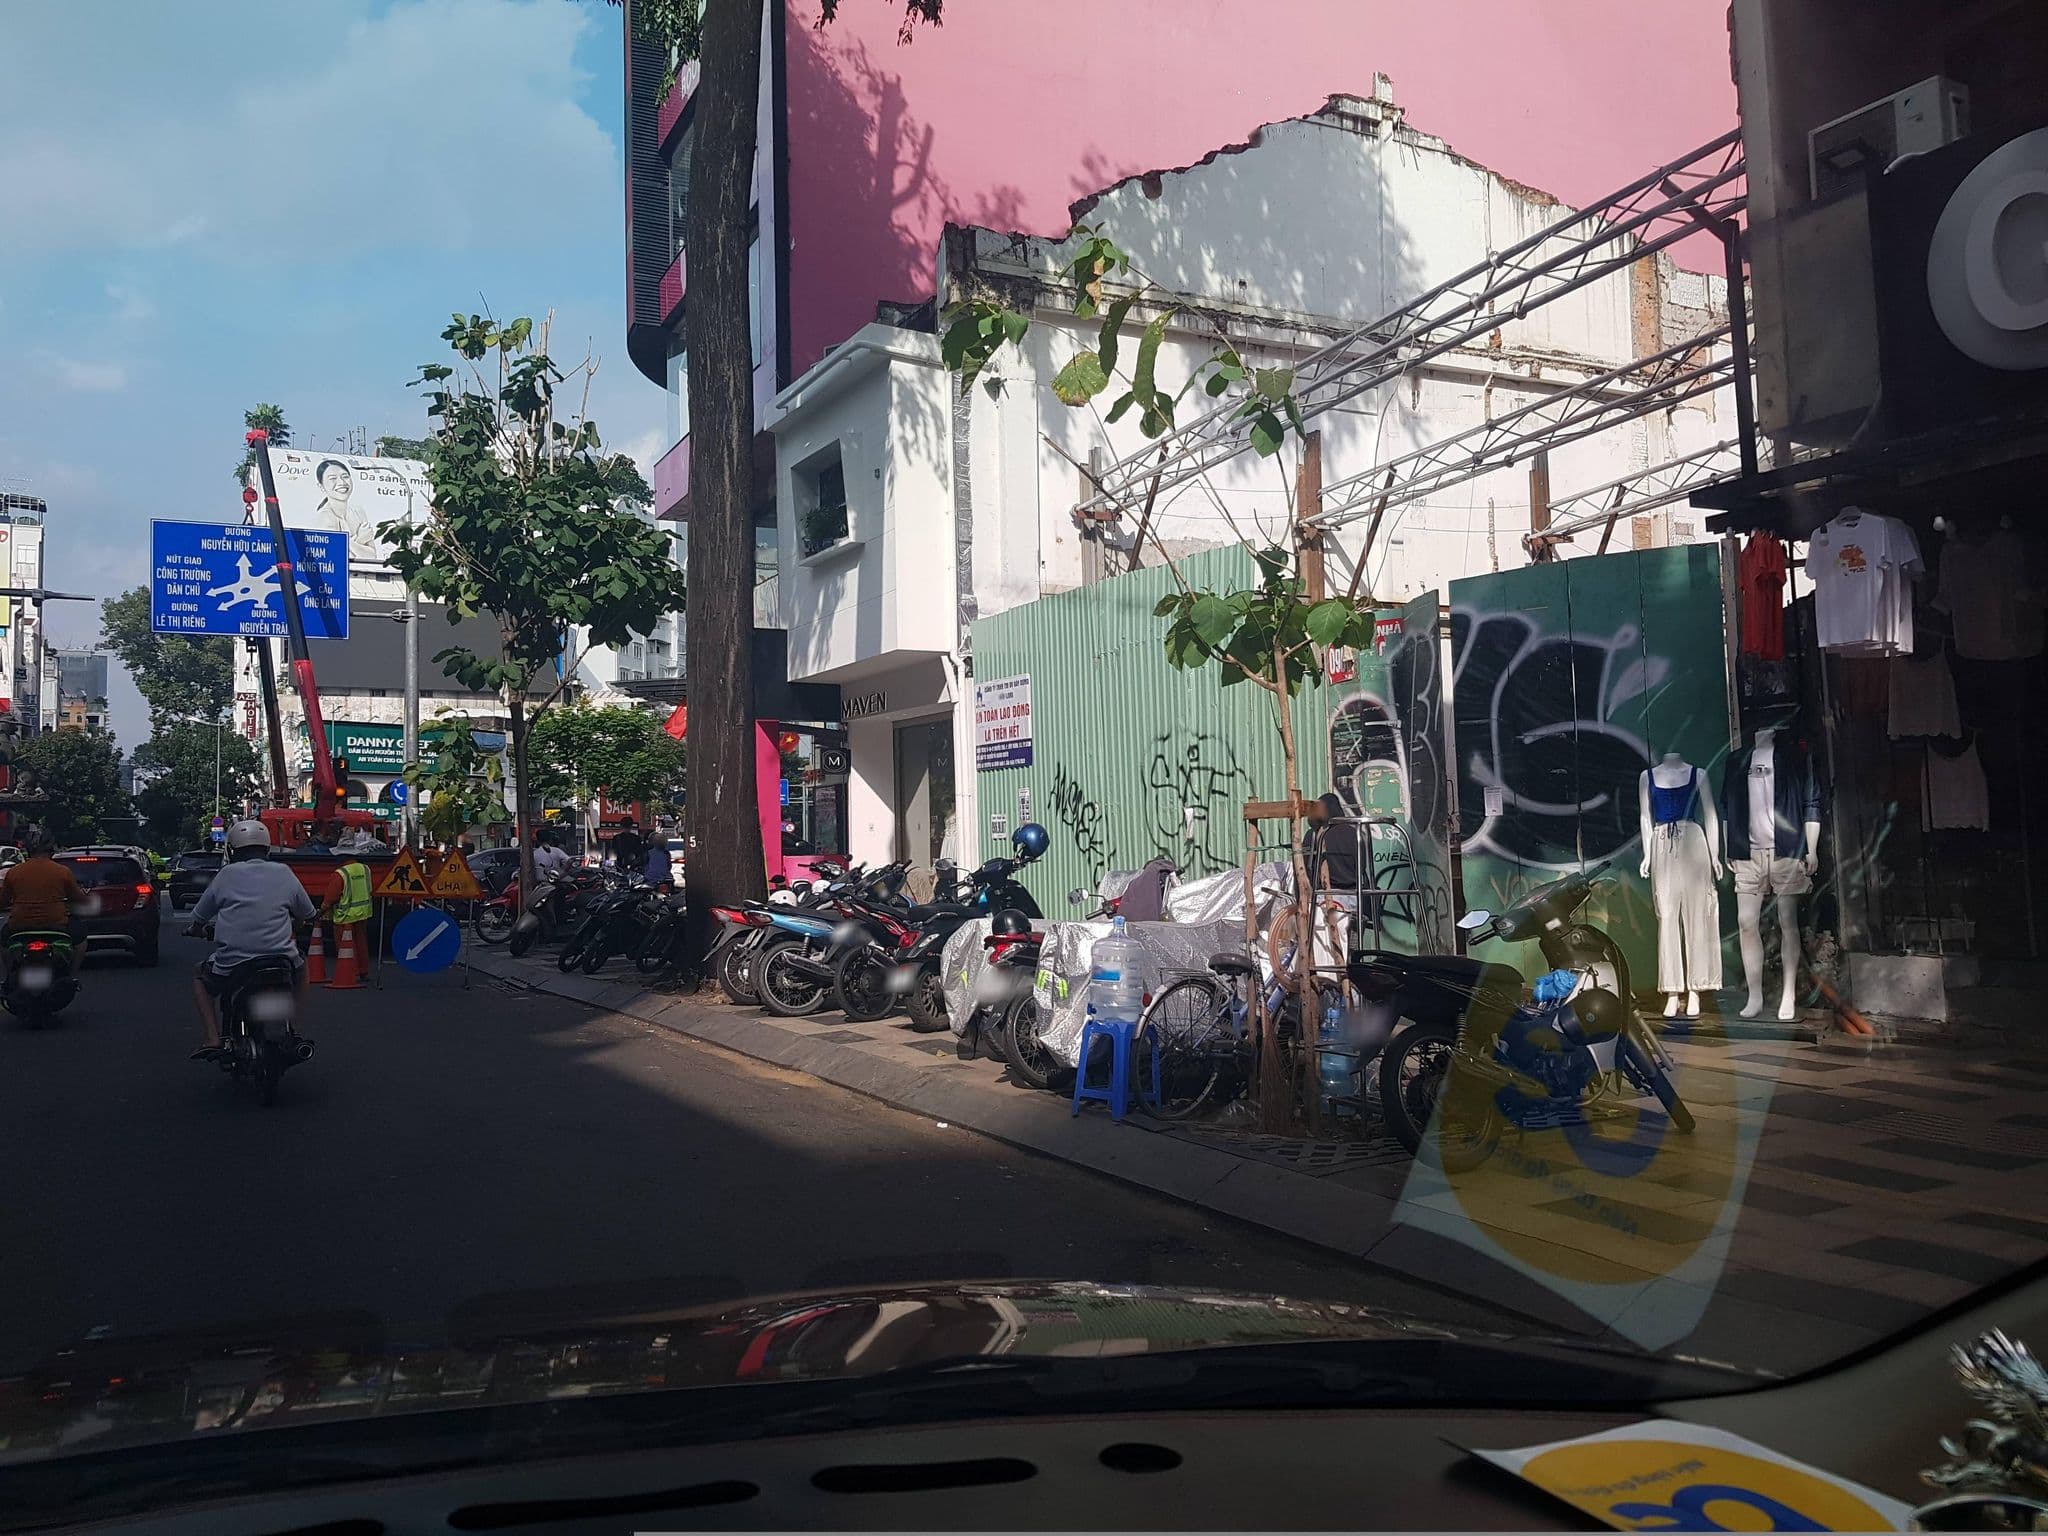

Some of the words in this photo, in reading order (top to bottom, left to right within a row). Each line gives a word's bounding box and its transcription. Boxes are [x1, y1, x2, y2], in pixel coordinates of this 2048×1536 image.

[277, 463, 310, 476] Dove
[360, 471, 376, 482] Da
[377, 486, 396, 496] tức
[225, 527, 251, 537] ĐƯỜNG
[201, 536, 232, 552] NGUYỄN
[234, 538, 249, 553] HỮU
[304, 534, 330, 544] ĐƯỜNG
[166, 554, 181, 565] NÚT
[184, 556, 202, 565] GIAO
[305, 547, 326, 560] PHẠM
[297, 560, 317, 573] HỒNG
[319, 560, 335, 574] THÁI
[156, 566, 178, 580] CÔNG
[180, 568, 211, 582] TRƯỜNG
[167, 581, 183, 596] DÂN
[184, 583, 201, 597] CHỦ
[319, 583, 333, 595] CẦU
[171, 602, 199, 612] ĐƯỜNG
[304, 595, 320, 608] ÔNG
[251, 609, 277, 619] ĐƯỜNG
[156, 613, 166, 627] LÊ
[168, 615, 180, 629] THỊ
[182, 614, 206, 629] RIÊNG
[239, 619, 270, 634] NGUYỄN
[1377, 621, 1402, 637] NHÀ
[842, 691, 887, 719] MAVEN
[984, 706, 998, 722] TOÀN
[1000, 706, 1011, 720] LAO
[1012, 702, 1030, 719] ĐỘNG
[247, 701, 256, 740] HOTEL
[984, 727, 991, 742] LÀ
[992, 725, 1007, 741] TRÊN
[1009, 720, 1020, 738] HẾT
[347, 736, 395, 748] DANNY
[828, 757, 840, 766] M
[606, 797, 633, 815] SALE
[689, 836, 697, 848] 5
